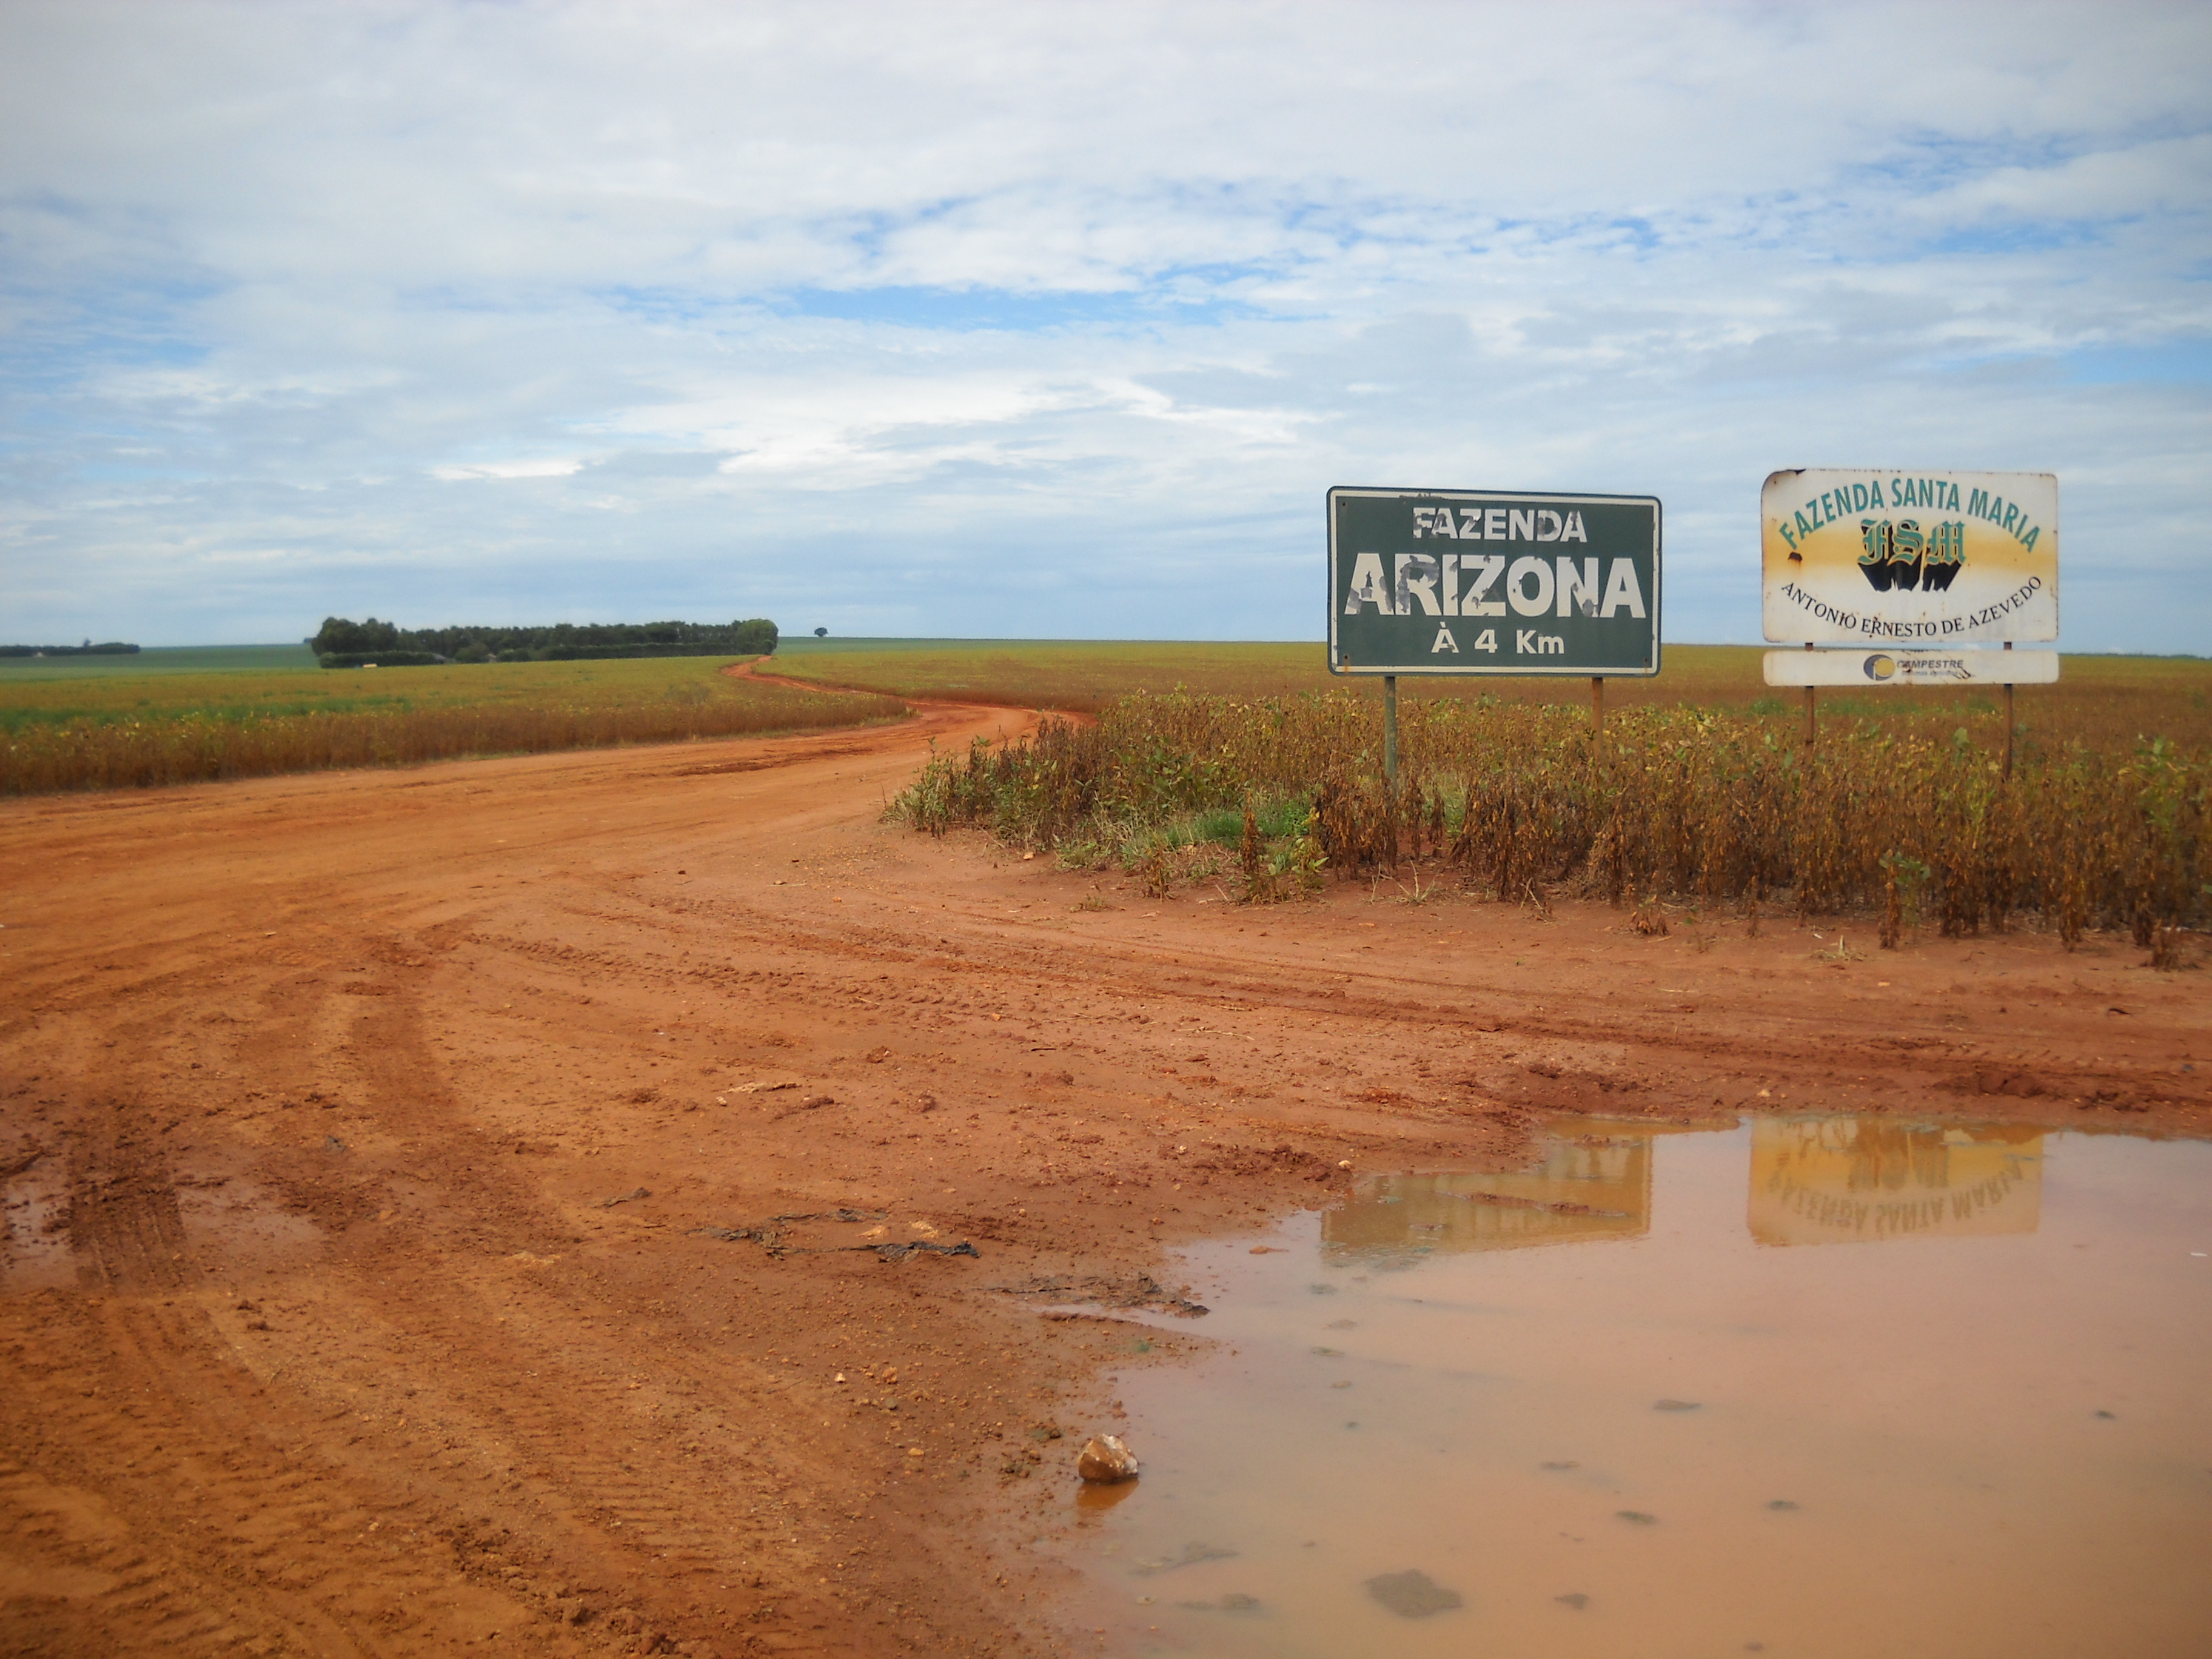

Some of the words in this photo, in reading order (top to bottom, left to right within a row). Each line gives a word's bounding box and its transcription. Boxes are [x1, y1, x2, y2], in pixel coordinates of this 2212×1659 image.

[1413, 508, 1587, 542] FAZENDA
[1779, 481, 1884, 550] FAZENDA
[1891, 478, 1960, 512] SANTA
[1967, 488, 2041, 553] MARIA
[1344, 553, 1646, 618] ARIZONA
[1781, 583, 1857, 629] ANTONIO
[1861, 618, 1937, 637] ERNESTO
[1942, 618, 1964, 634] DE
[1969, 577, 2041, 628] AZEVEDO
[1431, 621, 1459, 653] À
[1474, 629, 1497, 653] 4
[1517, 630, 1564, 654] Km
[1897, 660, 1963, 668] CAMPESTRE
